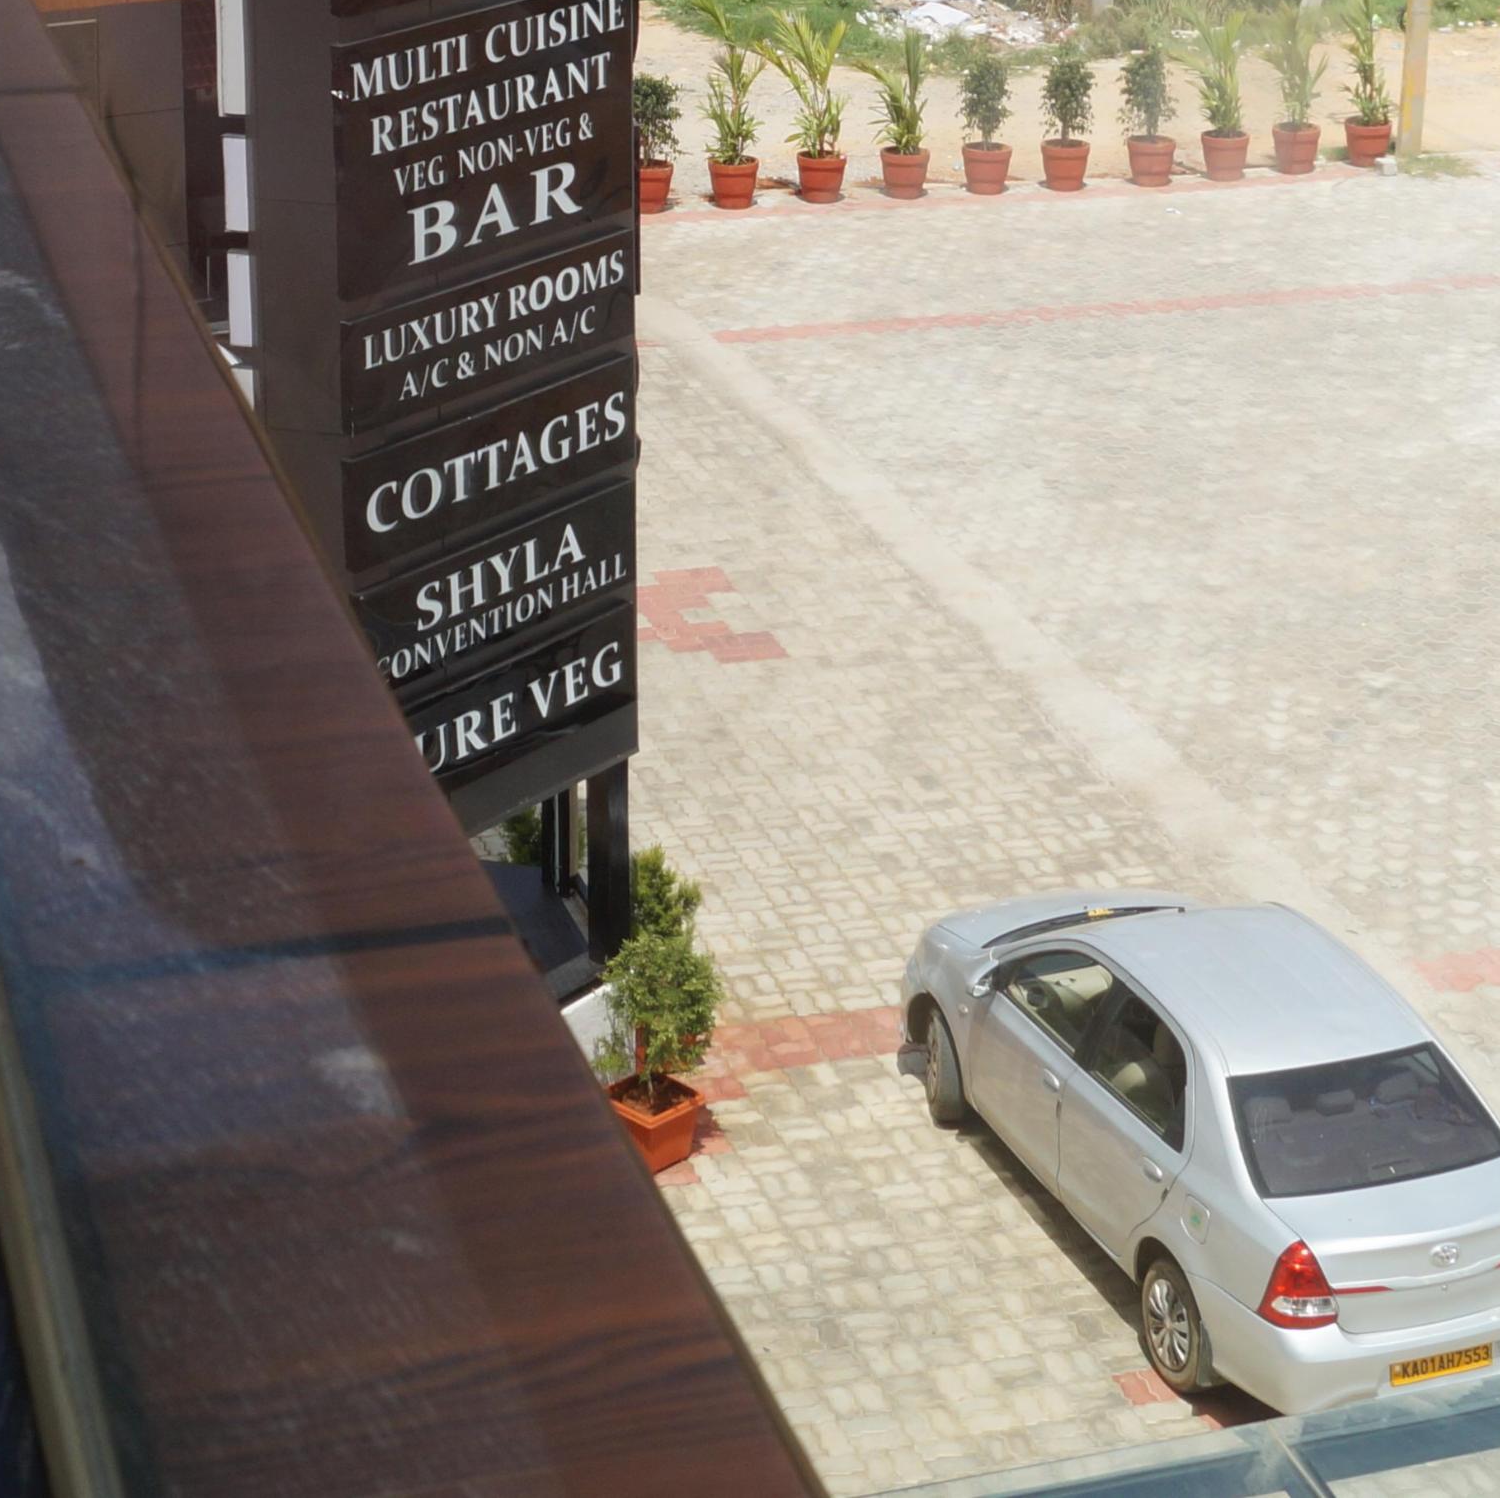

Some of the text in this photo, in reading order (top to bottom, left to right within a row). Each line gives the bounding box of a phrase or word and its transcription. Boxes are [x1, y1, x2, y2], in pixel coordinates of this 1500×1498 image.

[351, 33, 469, 102] MULTI
[371, 51, 611, 157] RESTAURANT
[394, 113, 593, 196] VEG NON-VEG &
[407, 162, 583, 266] BAR
[363, 249, 624, 371] LUXURY ROOMS
[399, 306, 596, 401] A/C & NON A/C
[365, 391, 626, 534] COTTAGES
[415, 523, 586, 632] SHYLA
[561, 553, 627, 606] HALL
[414, 641, 623, 773] URE VEG
[1402, 1345, 1490, 1379] KA01AH7553
